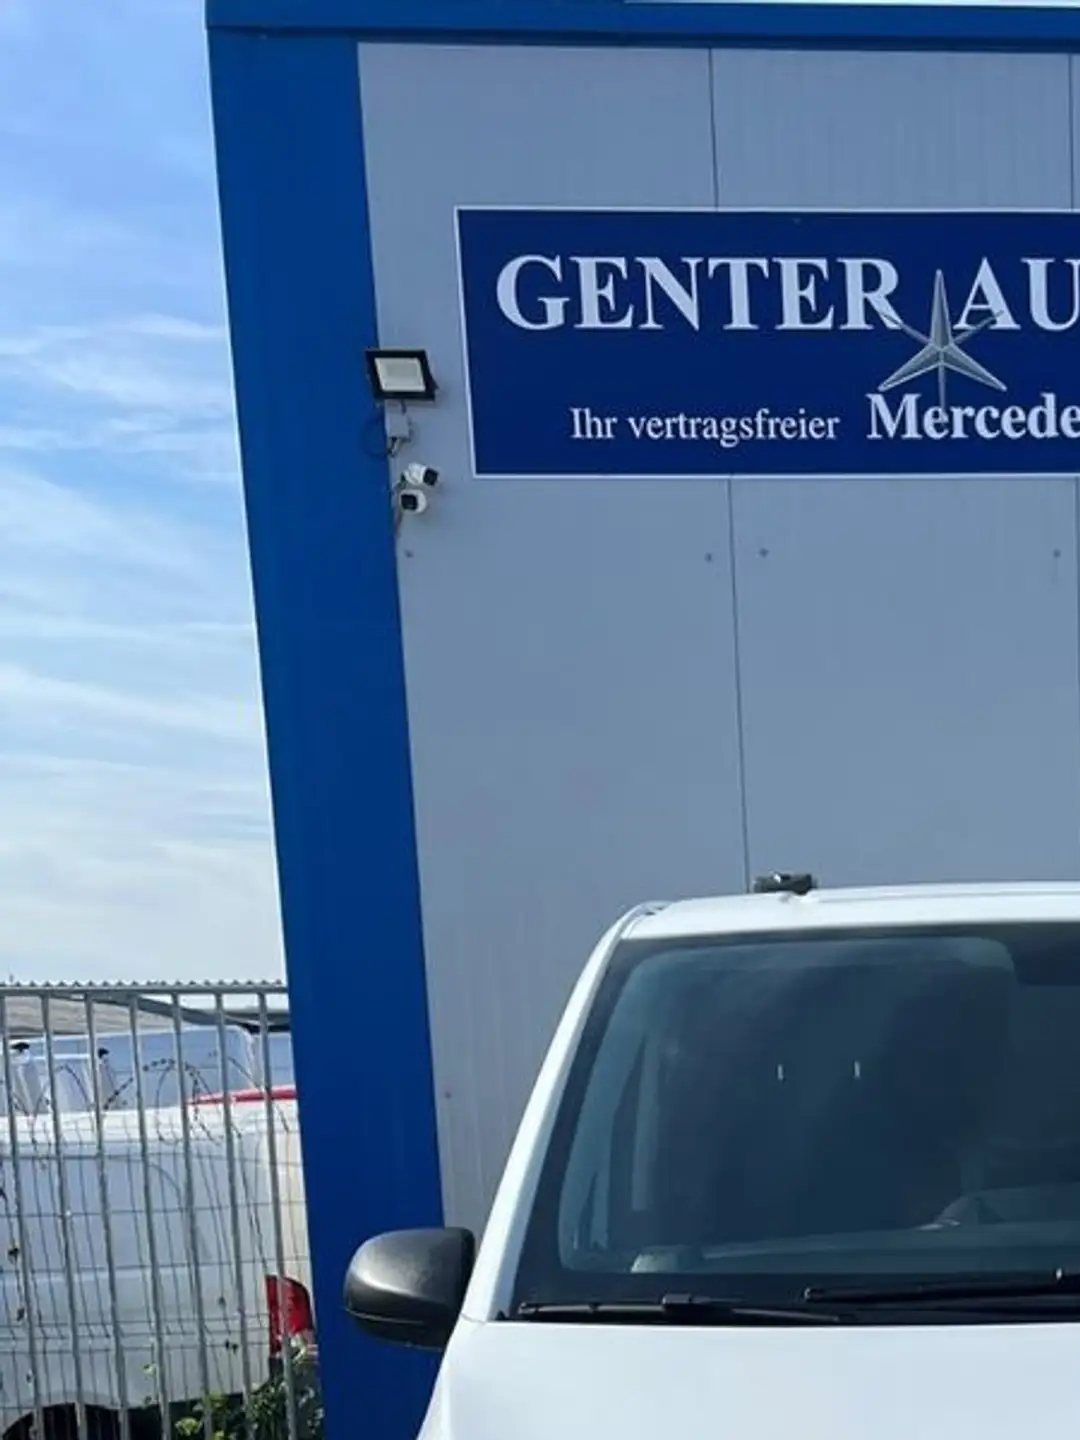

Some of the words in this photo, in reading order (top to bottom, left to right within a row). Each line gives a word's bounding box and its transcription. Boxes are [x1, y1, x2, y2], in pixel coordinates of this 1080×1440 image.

[496, 254, 901, 331] GENTER
[570, 407, 617, 440] Ihr
[628, 406, 841, 448] vertragsfreier
